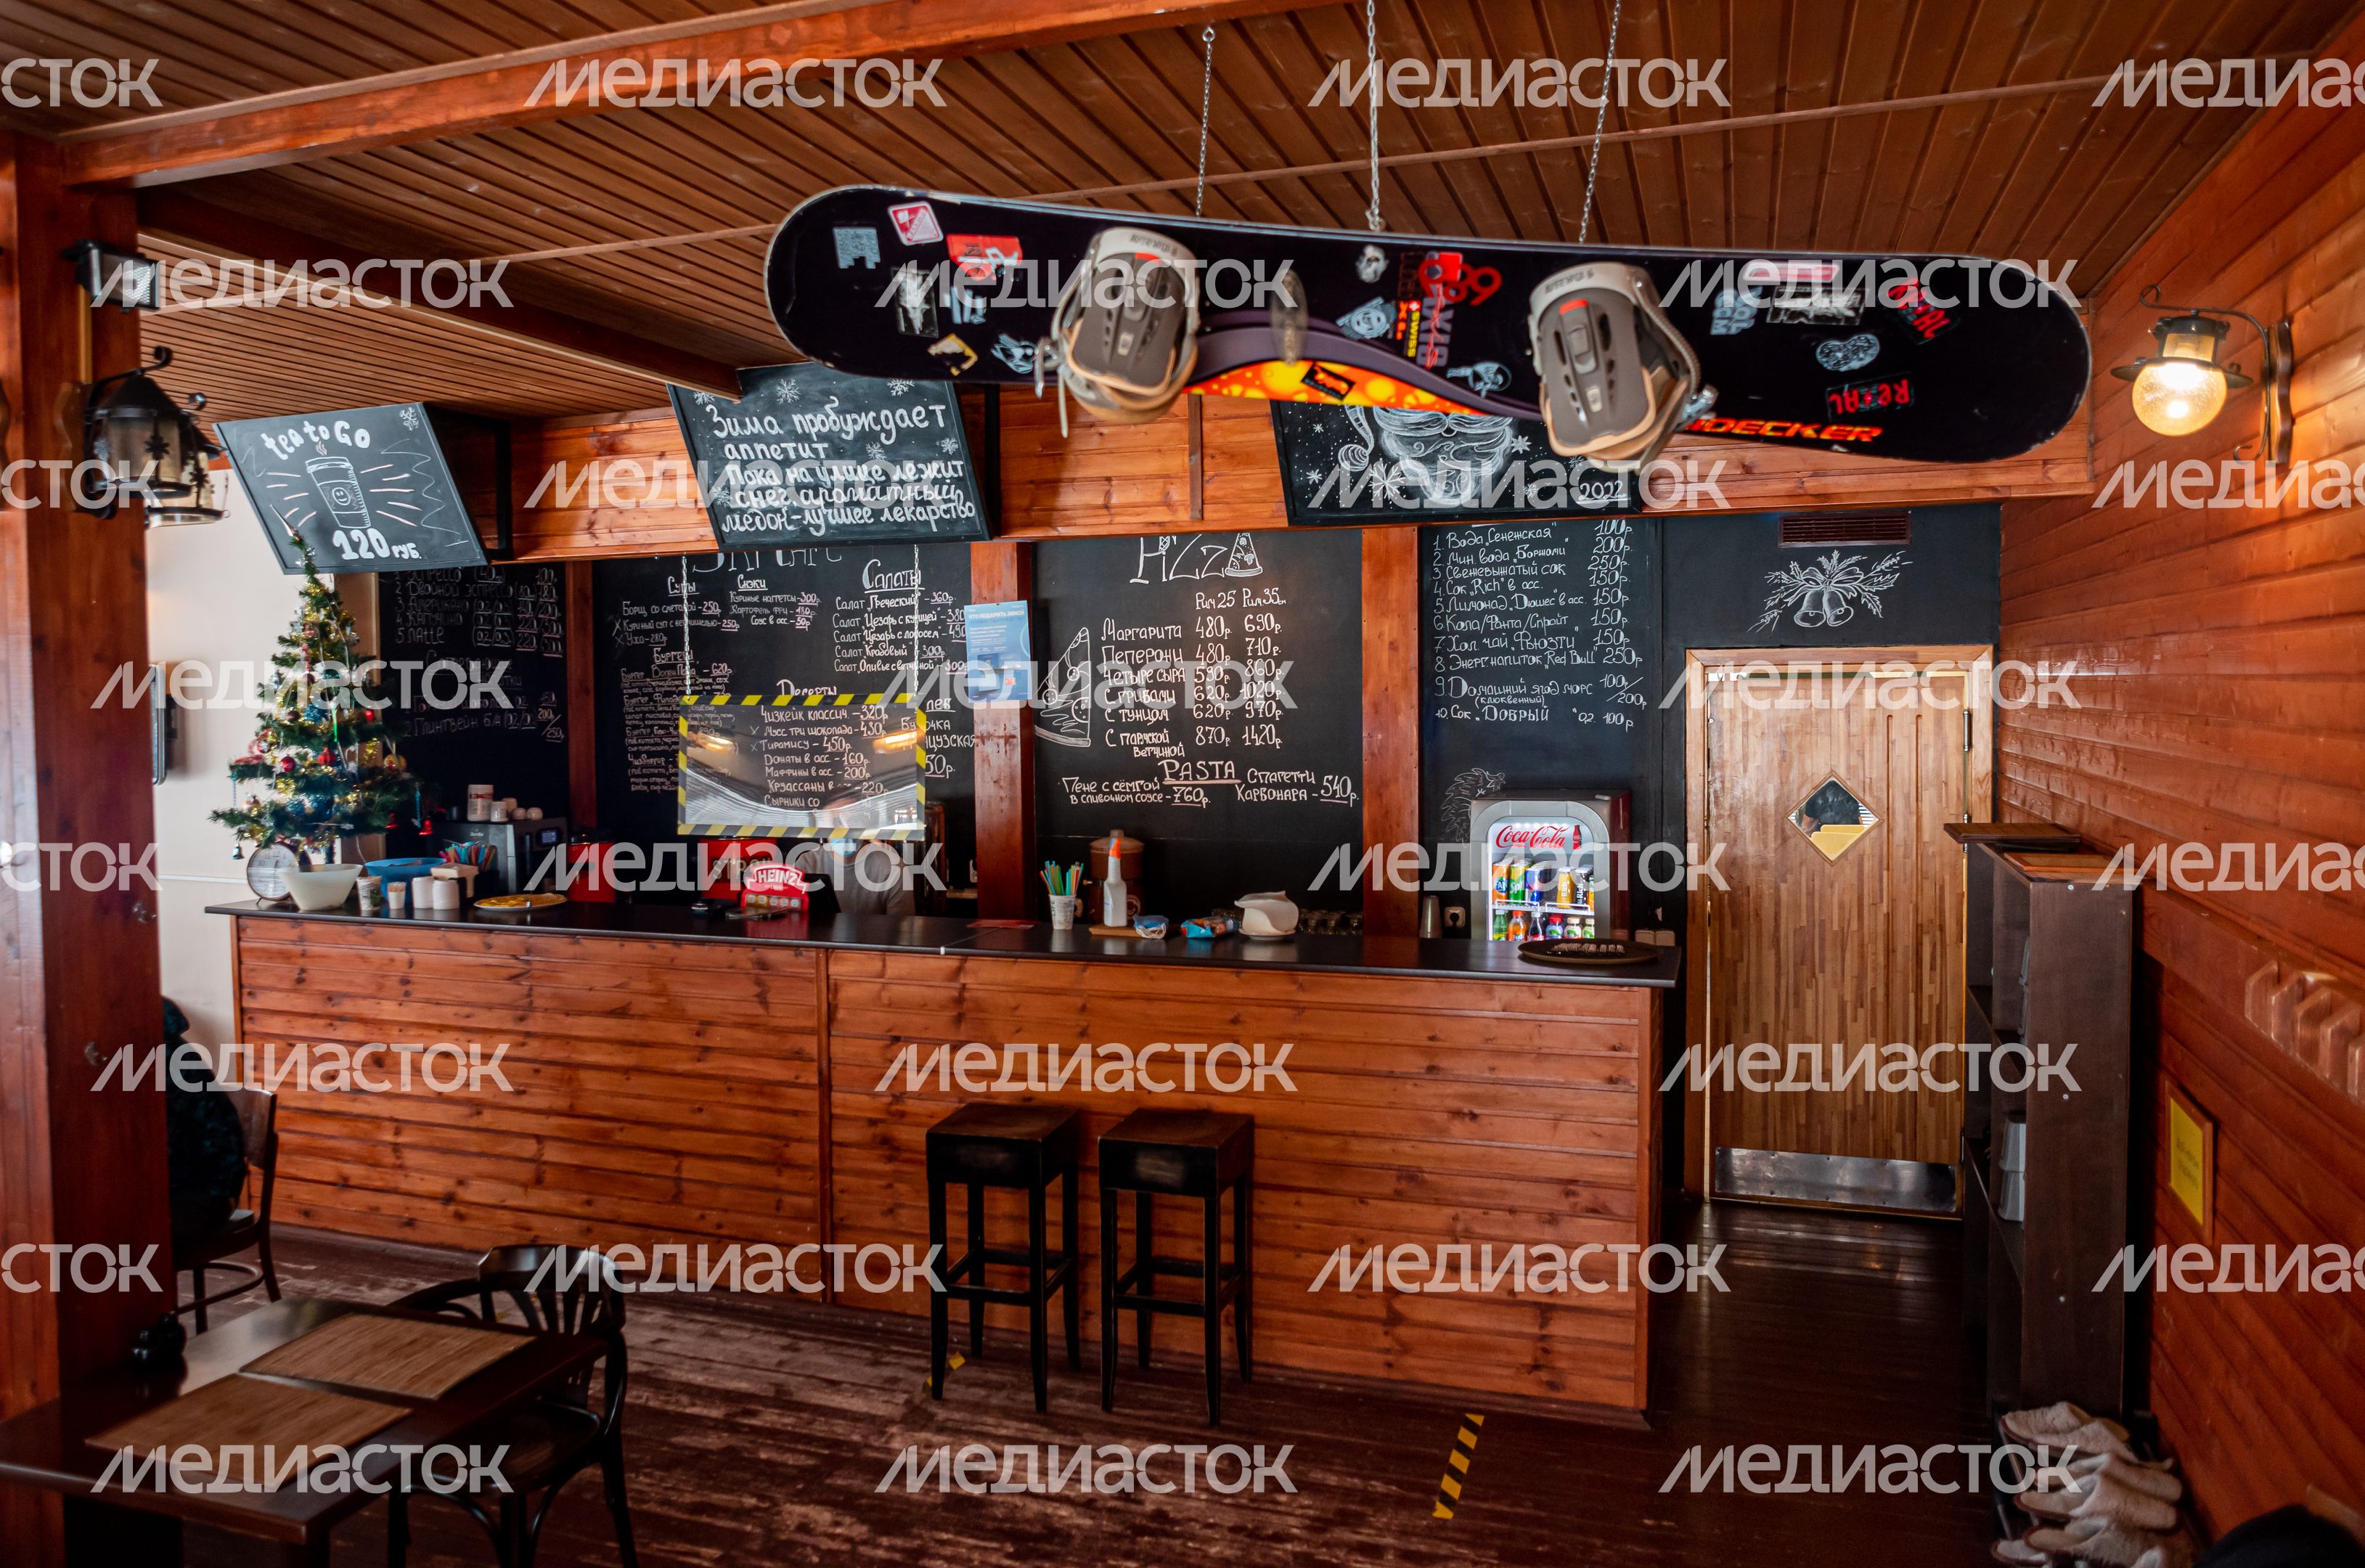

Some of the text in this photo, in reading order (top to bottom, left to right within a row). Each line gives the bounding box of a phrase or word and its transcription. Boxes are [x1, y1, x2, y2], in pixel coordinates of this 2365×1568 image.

[706, 396, 946, 445] Зима пробуждает
[303, 420, 330, 442] to
[724, 443, 828, 460] аппетит
[725, 460, 963, 488] Пока на улице лежит
[735, 479, 957, 513] снег, ароматный
[1578, 480, 1627, 501] 2022
[881, 489, 976, 531] лекарство
[332, 528, 391, 560] 120
[1446, 531, 1483, 549] Вода
[1447, 552, 1476, 565] Мин.
[862, 559, 921, 589] Салаты
[1446, 560, 1538, 579] Свежевыжатый
[738, 574, 766, 589] Снэки
[1446, 580, 1467, 595] Сок
[729, 591, 759, 603] Куриные
[836, 597, 865, 611] Салат
[1446, 595, 1508, 613] Лимонад
[622, 601, 648, 617] Борщ
[729, 605, 770, 618] Картофель
[624, 620, 654, 632] Куриный
[751, 615, 767, 625] Соус
[833, 613, 861, 628] Салат
[834, 631, 862, 643] Салат
[1101, 617, 1182, 641] Маргарита
[1447, 634, 1479, 652] Хол.
[1482, 633, 1508, 648] чай
[835, 645, 863, 658] Салат
[1102, 645, 1183, 664] Пеперони
[834, 659, 857, 672] Салат
[1490, 655, 1543, 666] напиток
[1103, 665, 1153, 686] Четыре
[1447, 676, 1527, 698] Домашний
[1562, 683, 1593, 695] морс
[1104, 688, 1116, 704] С
[1118, 690, 1176, 703] грибами
[1474, 695, 1545, 709] (клюквенный)
[761, 705, 804, 723] Чизкейк
[1105, 708, 1115, 722] С
[1119, 709, 1169, 726] тунцом
[1451, 704, 1472, 719] Сок
[764, 724, 853, 736] Мусс три шоколада
[1105, 728, 1116, 747] С
[1119, 728, 1169, 746] пармской
[759, 739, 809, 752] Тирамису
[764, 754, 801, 766] Донаты
[765, 767, 809, 777] Маффины
[1158, 759, 1235, 781] PASTA
[1247, 768, 1315, 784] Спагетти
[768, 780, 825, 793] Круассаны
[1062, 777, 1097, 793] Пене
[1113, 777, 1160, 792] сёмгой
[1235, 783, 1307, 801] Карбонара
[764, 795, 804, 807] Сырники
[1081, 793, 1133, 804] сливочном
[1135, 793, 1163, 803] соусе
[1495, 825, 1570, 849] Coca-Cola
[758, 868, 799, 887] HEINZ
